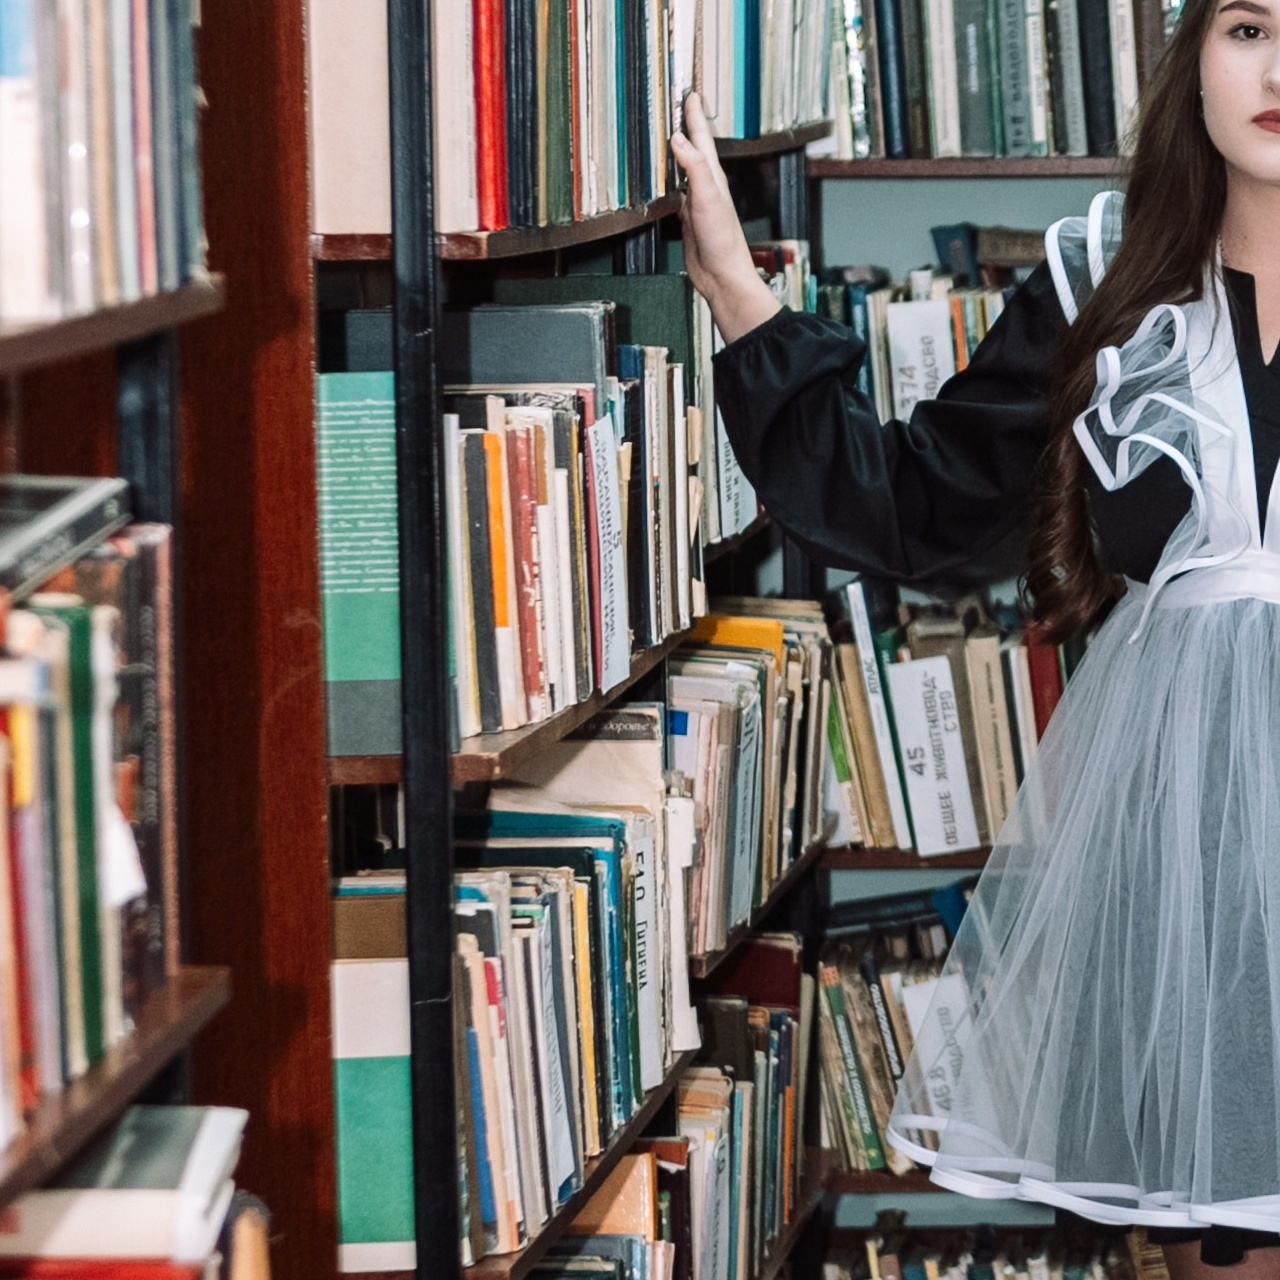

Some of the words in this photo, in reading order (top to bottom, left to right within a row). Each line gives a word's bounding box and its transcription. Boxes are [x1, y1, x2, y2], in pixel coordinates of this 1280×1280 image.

[864, 656, 881, 695] АТЛАС
[921, 670, 949, 782] ЖИВОТНОВОД-
[940, 690, 958, 733] СТВО
[907, 746, 927, 776] 45
[938, 791, 959, 846] ОБЩЕЕ
